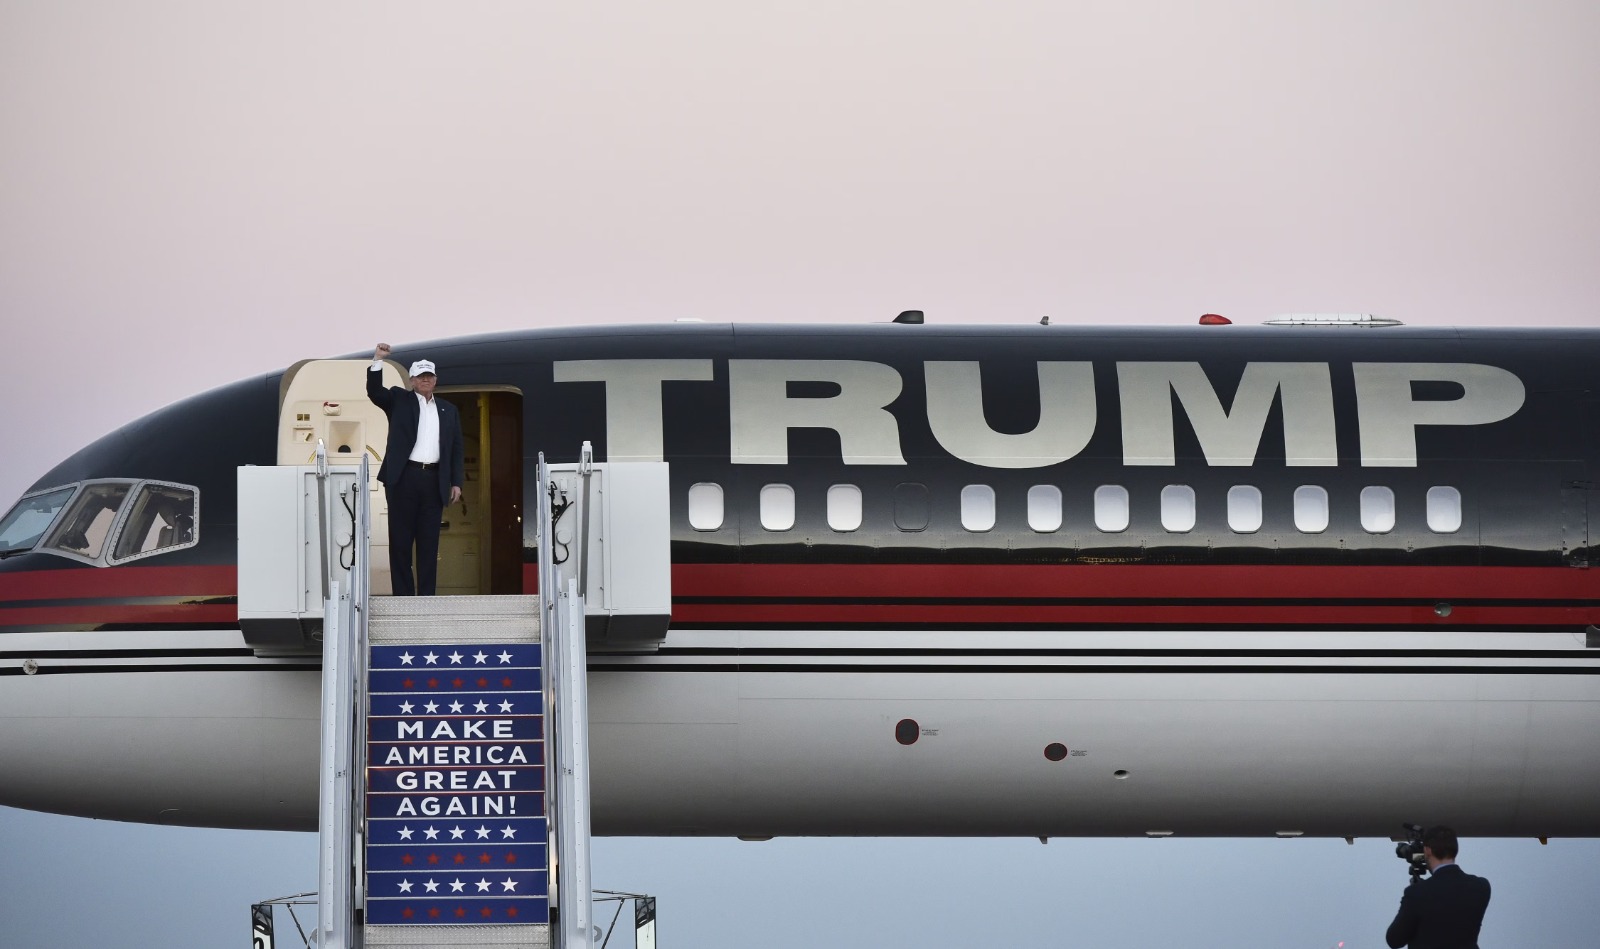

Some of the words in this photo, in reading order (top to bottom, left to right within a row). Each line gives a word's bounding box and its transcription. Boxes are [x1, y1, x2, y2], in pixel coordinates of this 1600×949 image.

[552, 359, 1526, 469] TRUMP
[397, 720, 514, 738] MAKE
[385, 746, 528, 764] AMERICA
[396, 771, 517, 789] GREAT
[396, 796, 516, 815] AGAIN!
